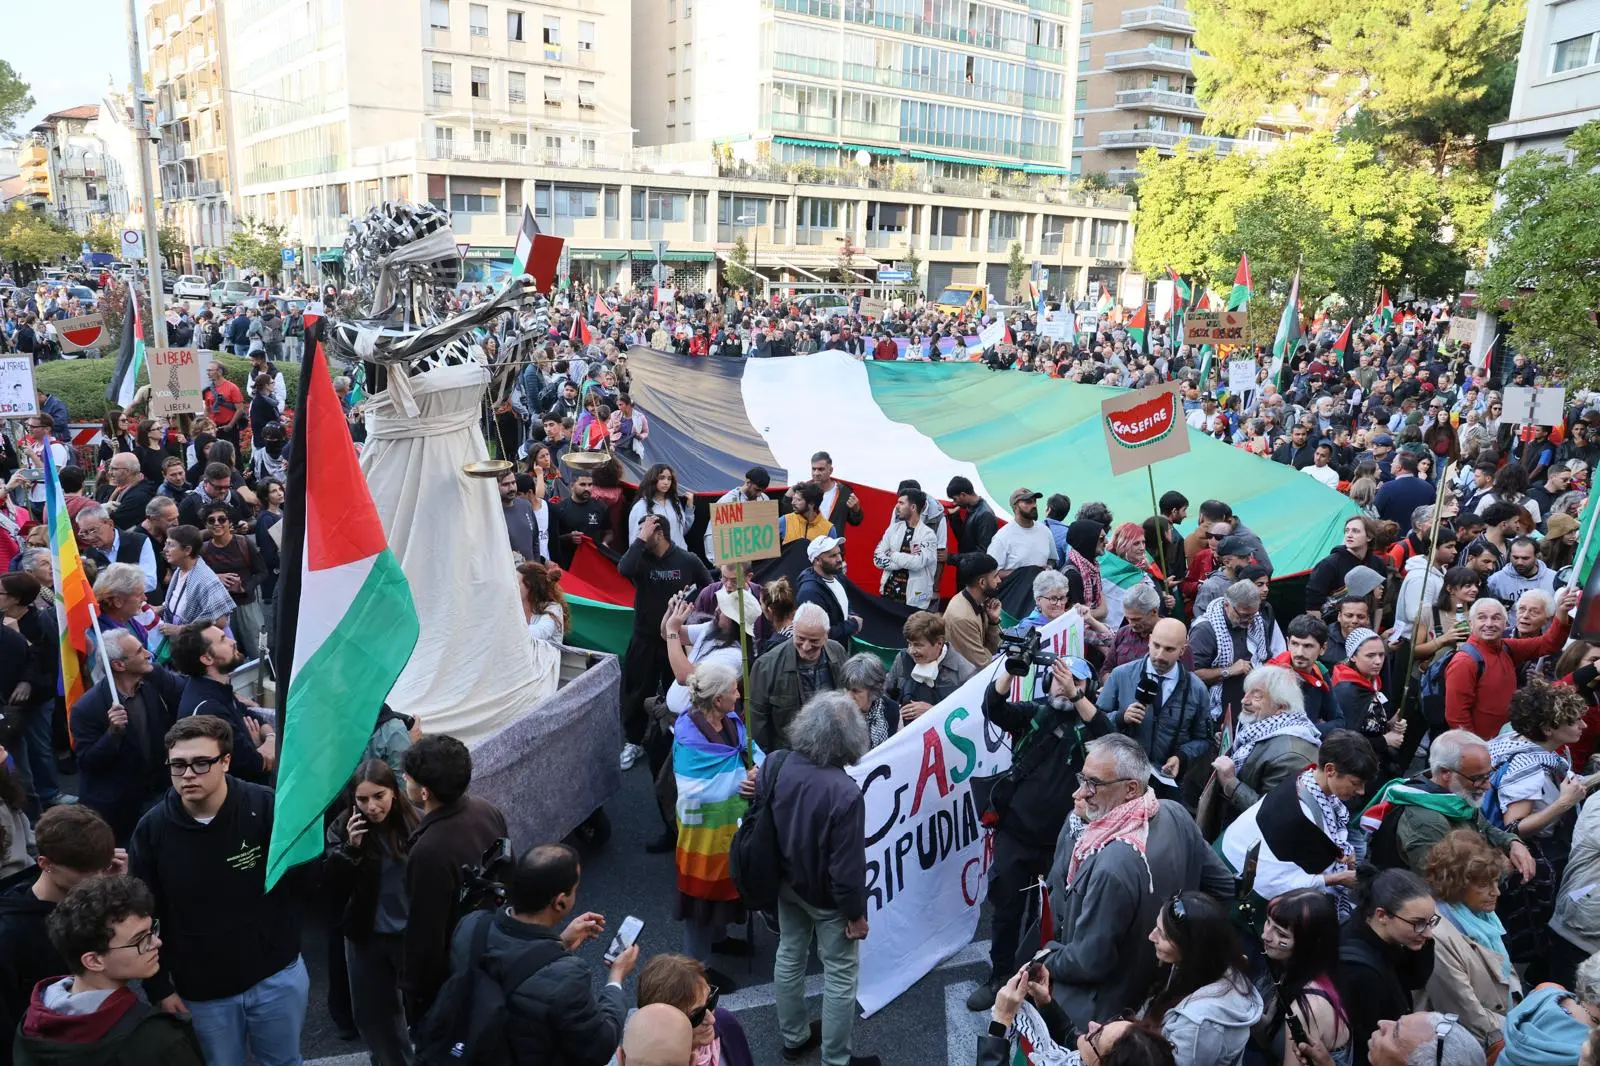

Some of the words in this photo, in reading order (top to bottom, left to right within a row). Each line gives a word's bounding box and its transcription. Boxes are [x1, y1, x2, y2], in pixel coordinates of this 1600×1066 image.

[156, 351, 194, 366] LIBERA
[0, 403, 12, 413] ED
[164, 403, 191, 412] LIBERA
[1113, 408, 1167, 435] CEASEFIRE
[715, 502, 743, 526] ANAN
[720, 523, 773, 560] LIBERO
